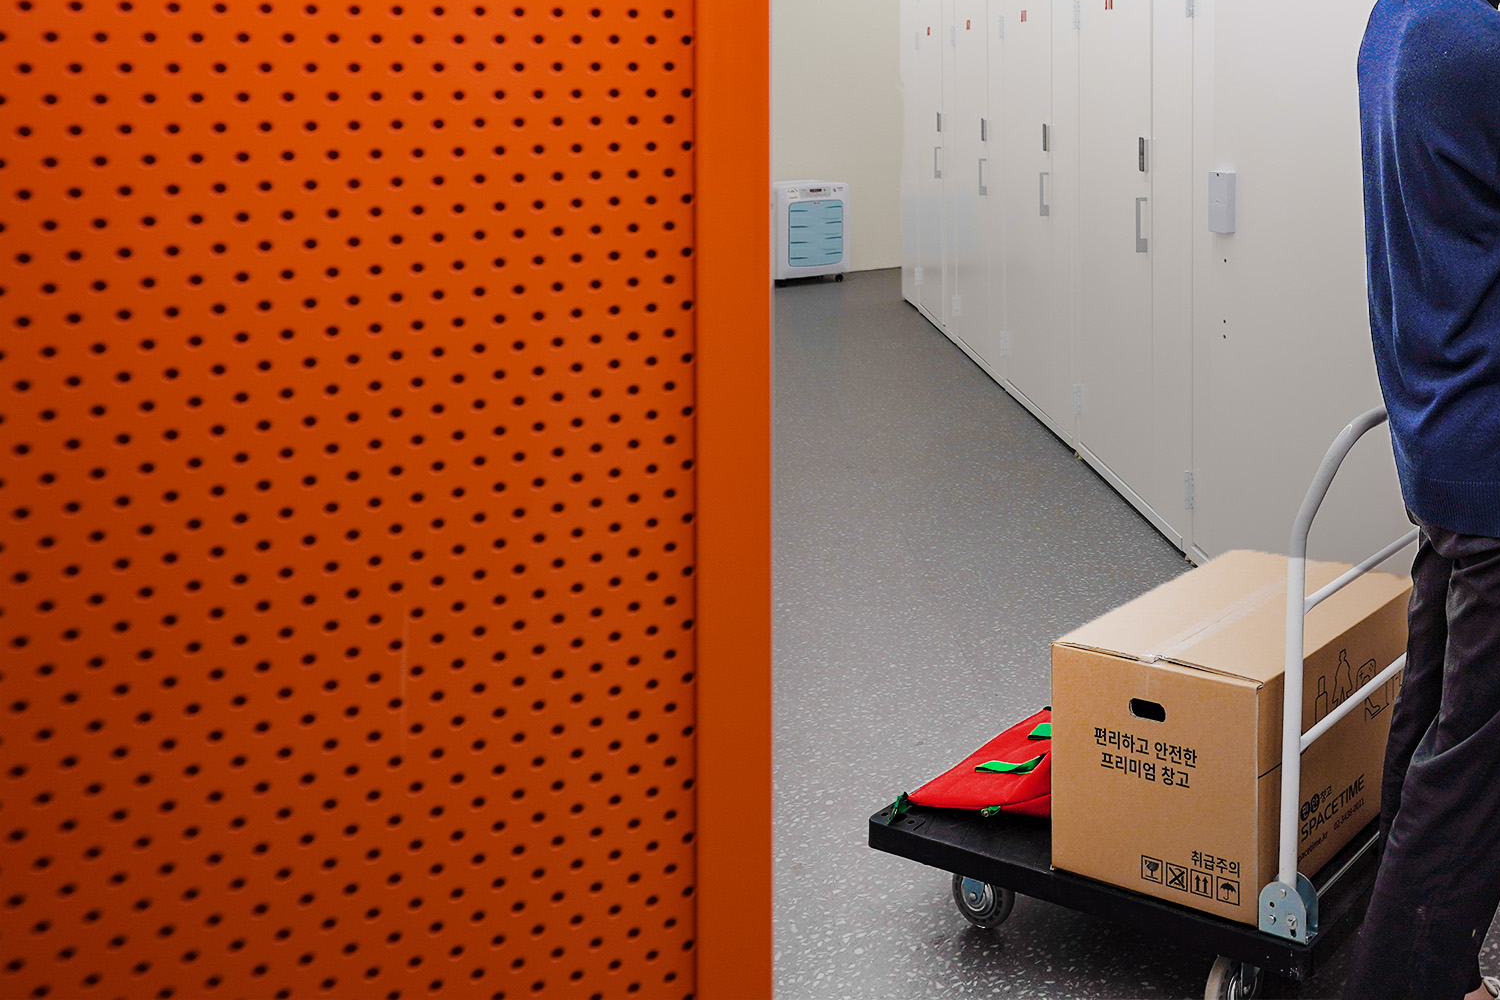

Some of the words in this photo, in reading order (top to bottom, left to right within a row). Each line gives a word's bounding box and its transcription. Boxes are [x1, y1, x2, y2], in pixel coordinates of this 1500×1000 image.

[1093, 726, 1150, 756] 편리하고
[1153, 741, 1198, 769] 안전한
[1100, 752, 1156, 782] 프리미엄
[1161, 765, 1190, 789] 창고
[1301, 773, 1365, 843] SPACETIME
[1191, 850, 1240, 879] 취급주의
